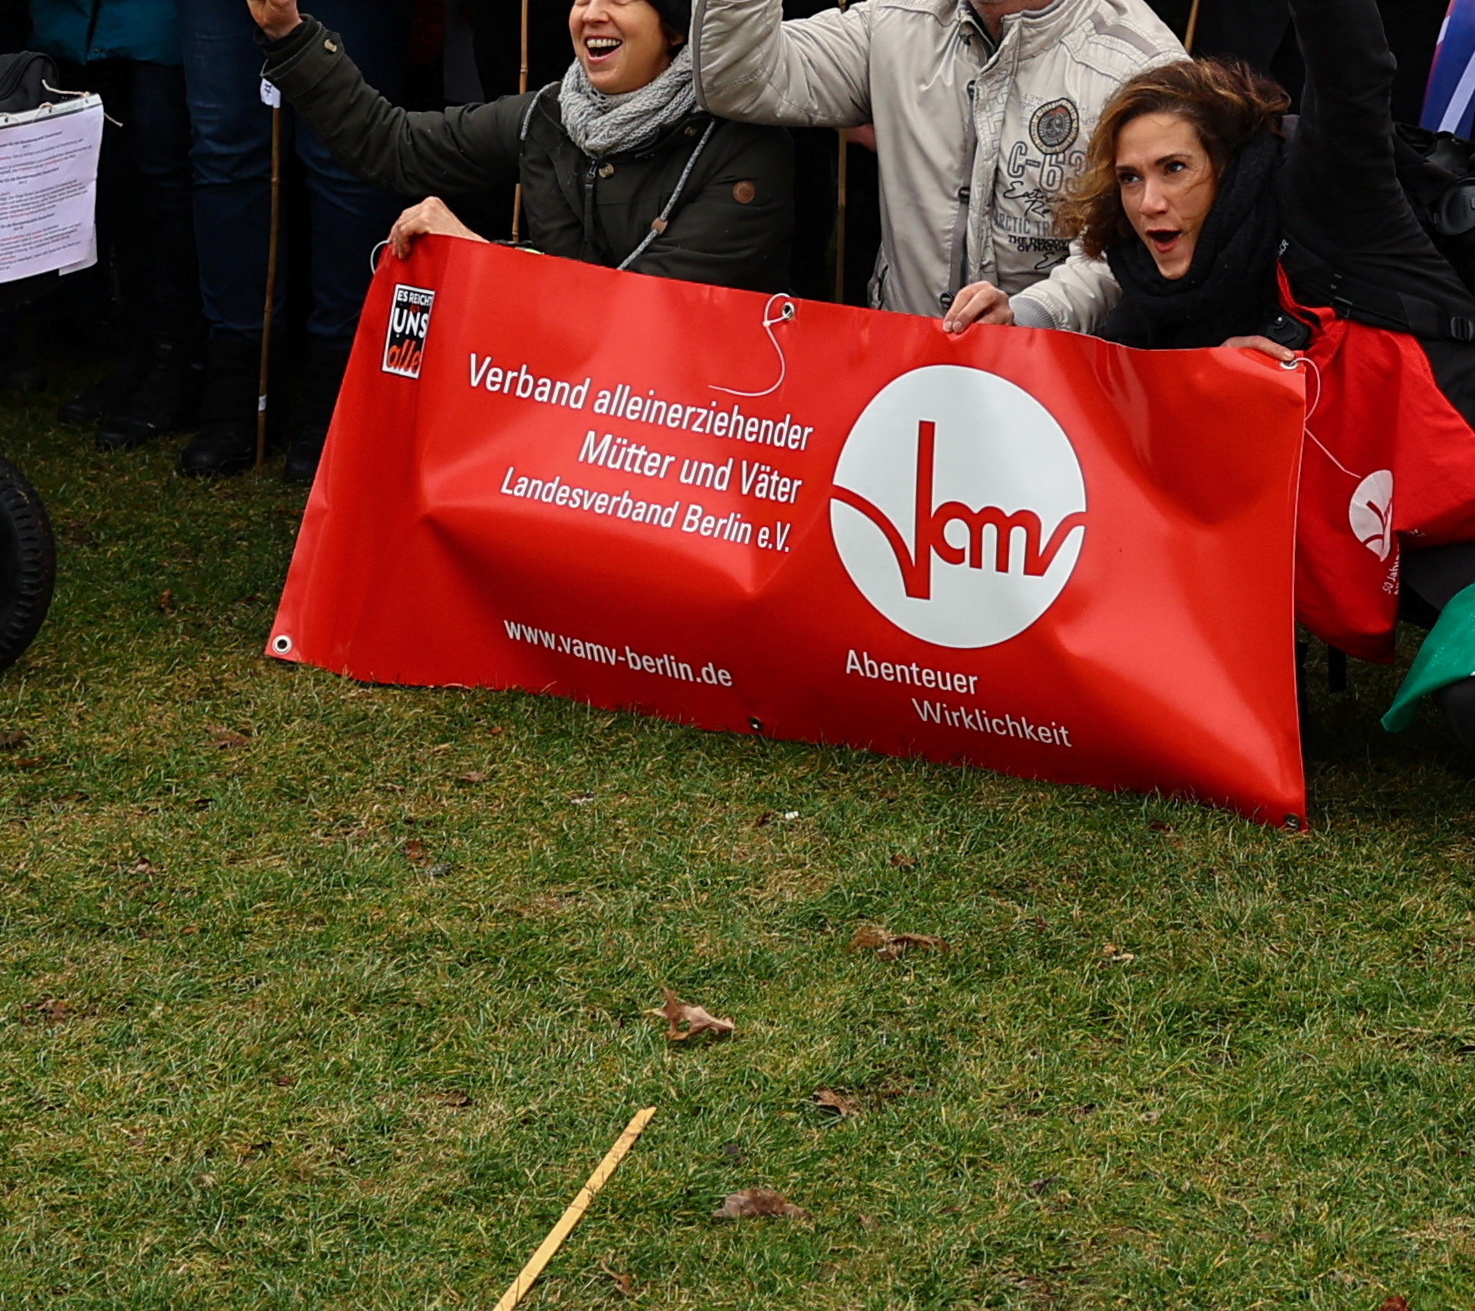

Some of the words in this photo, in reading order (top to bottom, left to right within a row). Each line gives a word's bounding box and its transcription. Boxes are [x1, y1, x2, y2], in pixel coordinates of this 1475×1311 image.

[1008, 235, 1027, 245] THE
[397, 289, 410, 303] ES
[392, 307, 430, 338] UNS
[387, 338, 422, 375] alle
[469, 352, 592, 410] Verband
[593, 383, 814, 452] alleinerziehender
[578, 430, 675, 480] Mütter
[679, 457, 734, 492] und
[740, 459, 803, 505] Väter
[500, 466, 680, 530] Landesverband
[682, 504, 754, 545] Berlin
[757, 521, 792, 553] e.V.
[503, 619, 734, 688] www.vamv-berlin.de
[845, 649, 980, 696] Abenteuer
[911, 697, 1074, 749] Wirklichkeit
